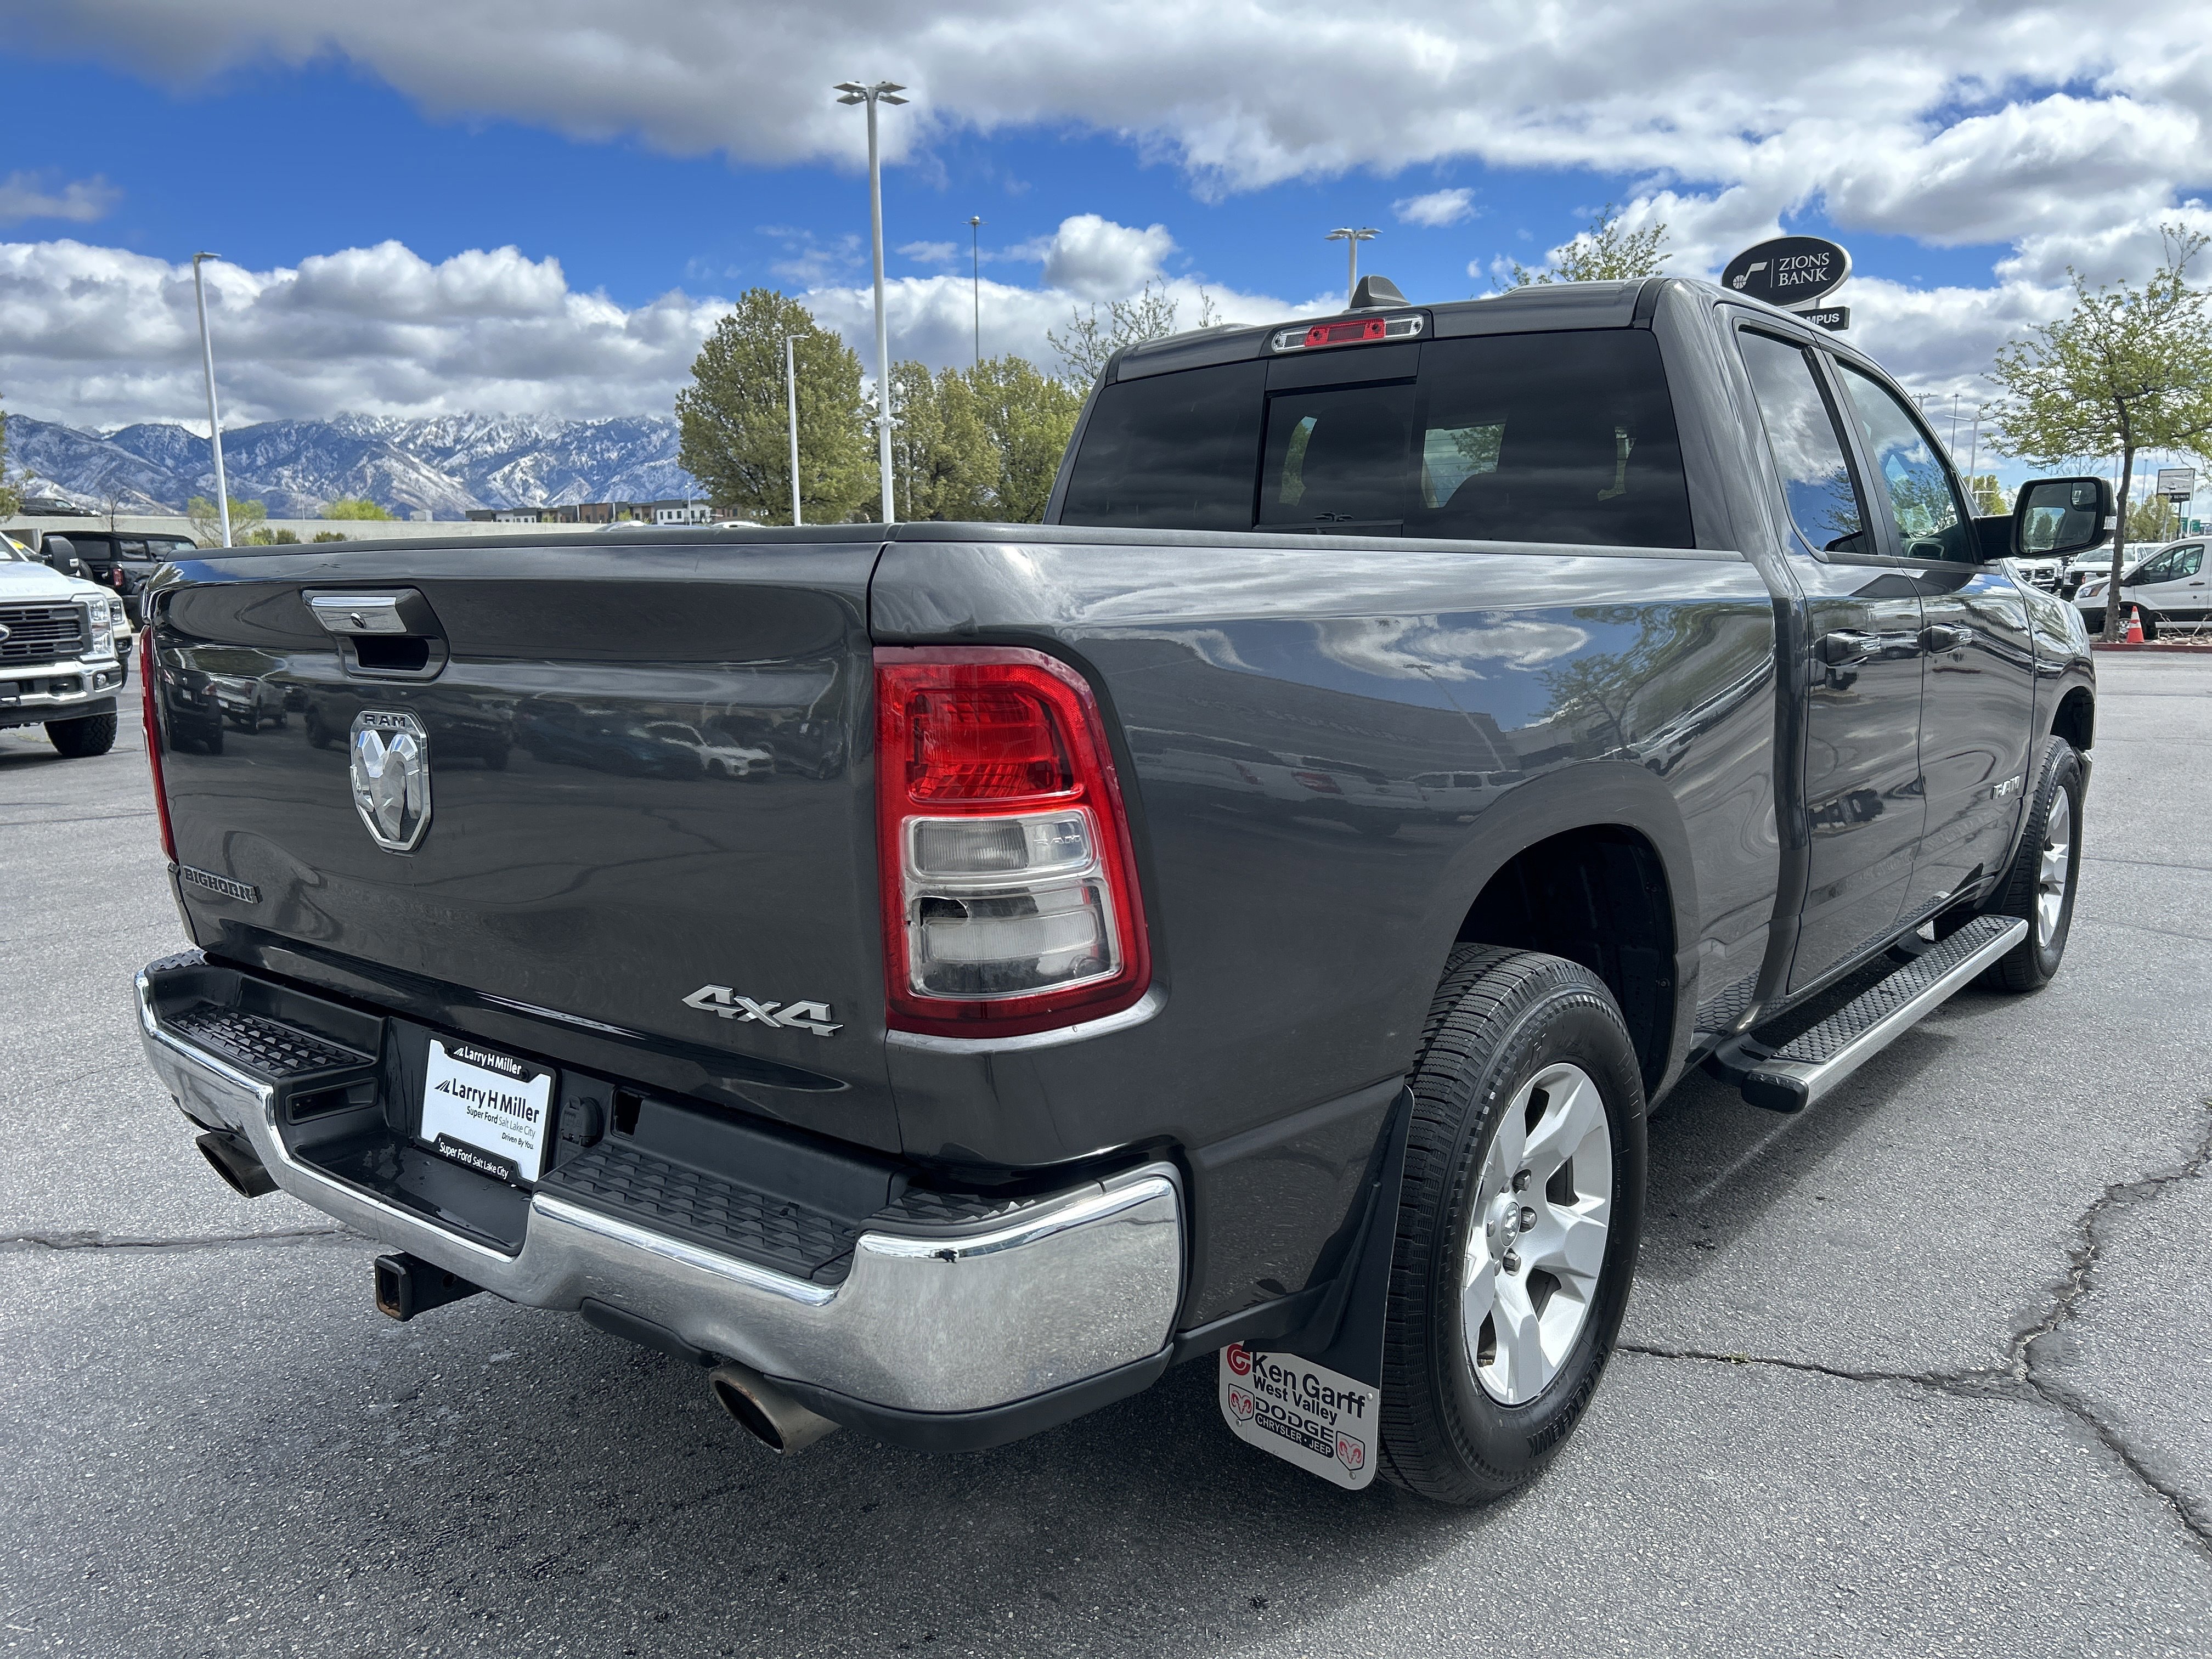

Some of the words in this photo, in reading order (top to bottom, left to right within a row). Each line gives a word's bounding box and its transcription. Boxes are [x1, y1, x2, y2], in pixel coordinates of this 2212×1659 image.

[1778, 267, 1828, 286] BANK
[1779, 252, 1830, 271] ZIONS
[1805, 313, 1839, 324] MPUS
[363, 714, 406, 727] RAM
[183, 865, 256, 904] BIGHORN
[464, 1046, 487, 1066] Larry
[487, 1053, 495, 1066] H
[494, 1056, 522, 1075] Miller
[452, 1078, 486, 1109] Larry
[487, 1090, 498, 1109] H
[499, 1094, 540, 1123] Miller
[466, 1105, 484, 1119] Super
[484, 1111, 499, 1124] Ford
[498, 1116, 509, 1128] Salt
[510, 1120, 523, 1133] Lake
[524, 1125, 536, 1139] City
[501, 1132, 517, 1144] Driven
[517, 1139, 524, 1148] By
[439, 1142, 458, 1157] Super
[457, 1148, 472, 1163] Ford
[472, 1156, 484, 1169] Salt
[483, 1161, 496, 1173] Lake
[497, 1166, 509, 1180] City
[1252, 1352, 1296, 1391] Ken
[1302, 1373, 1365, 1419] Garff
[1253, 1374, 1288, 1402] West
[1292, 1390, 1338, 1426] Valley
[1255, 1396, 1334, 1443] DODGE
[1257, 1415, 1302, 1443] CHRYSLER
[1309, 1440, 1331, 1455] JEEP
